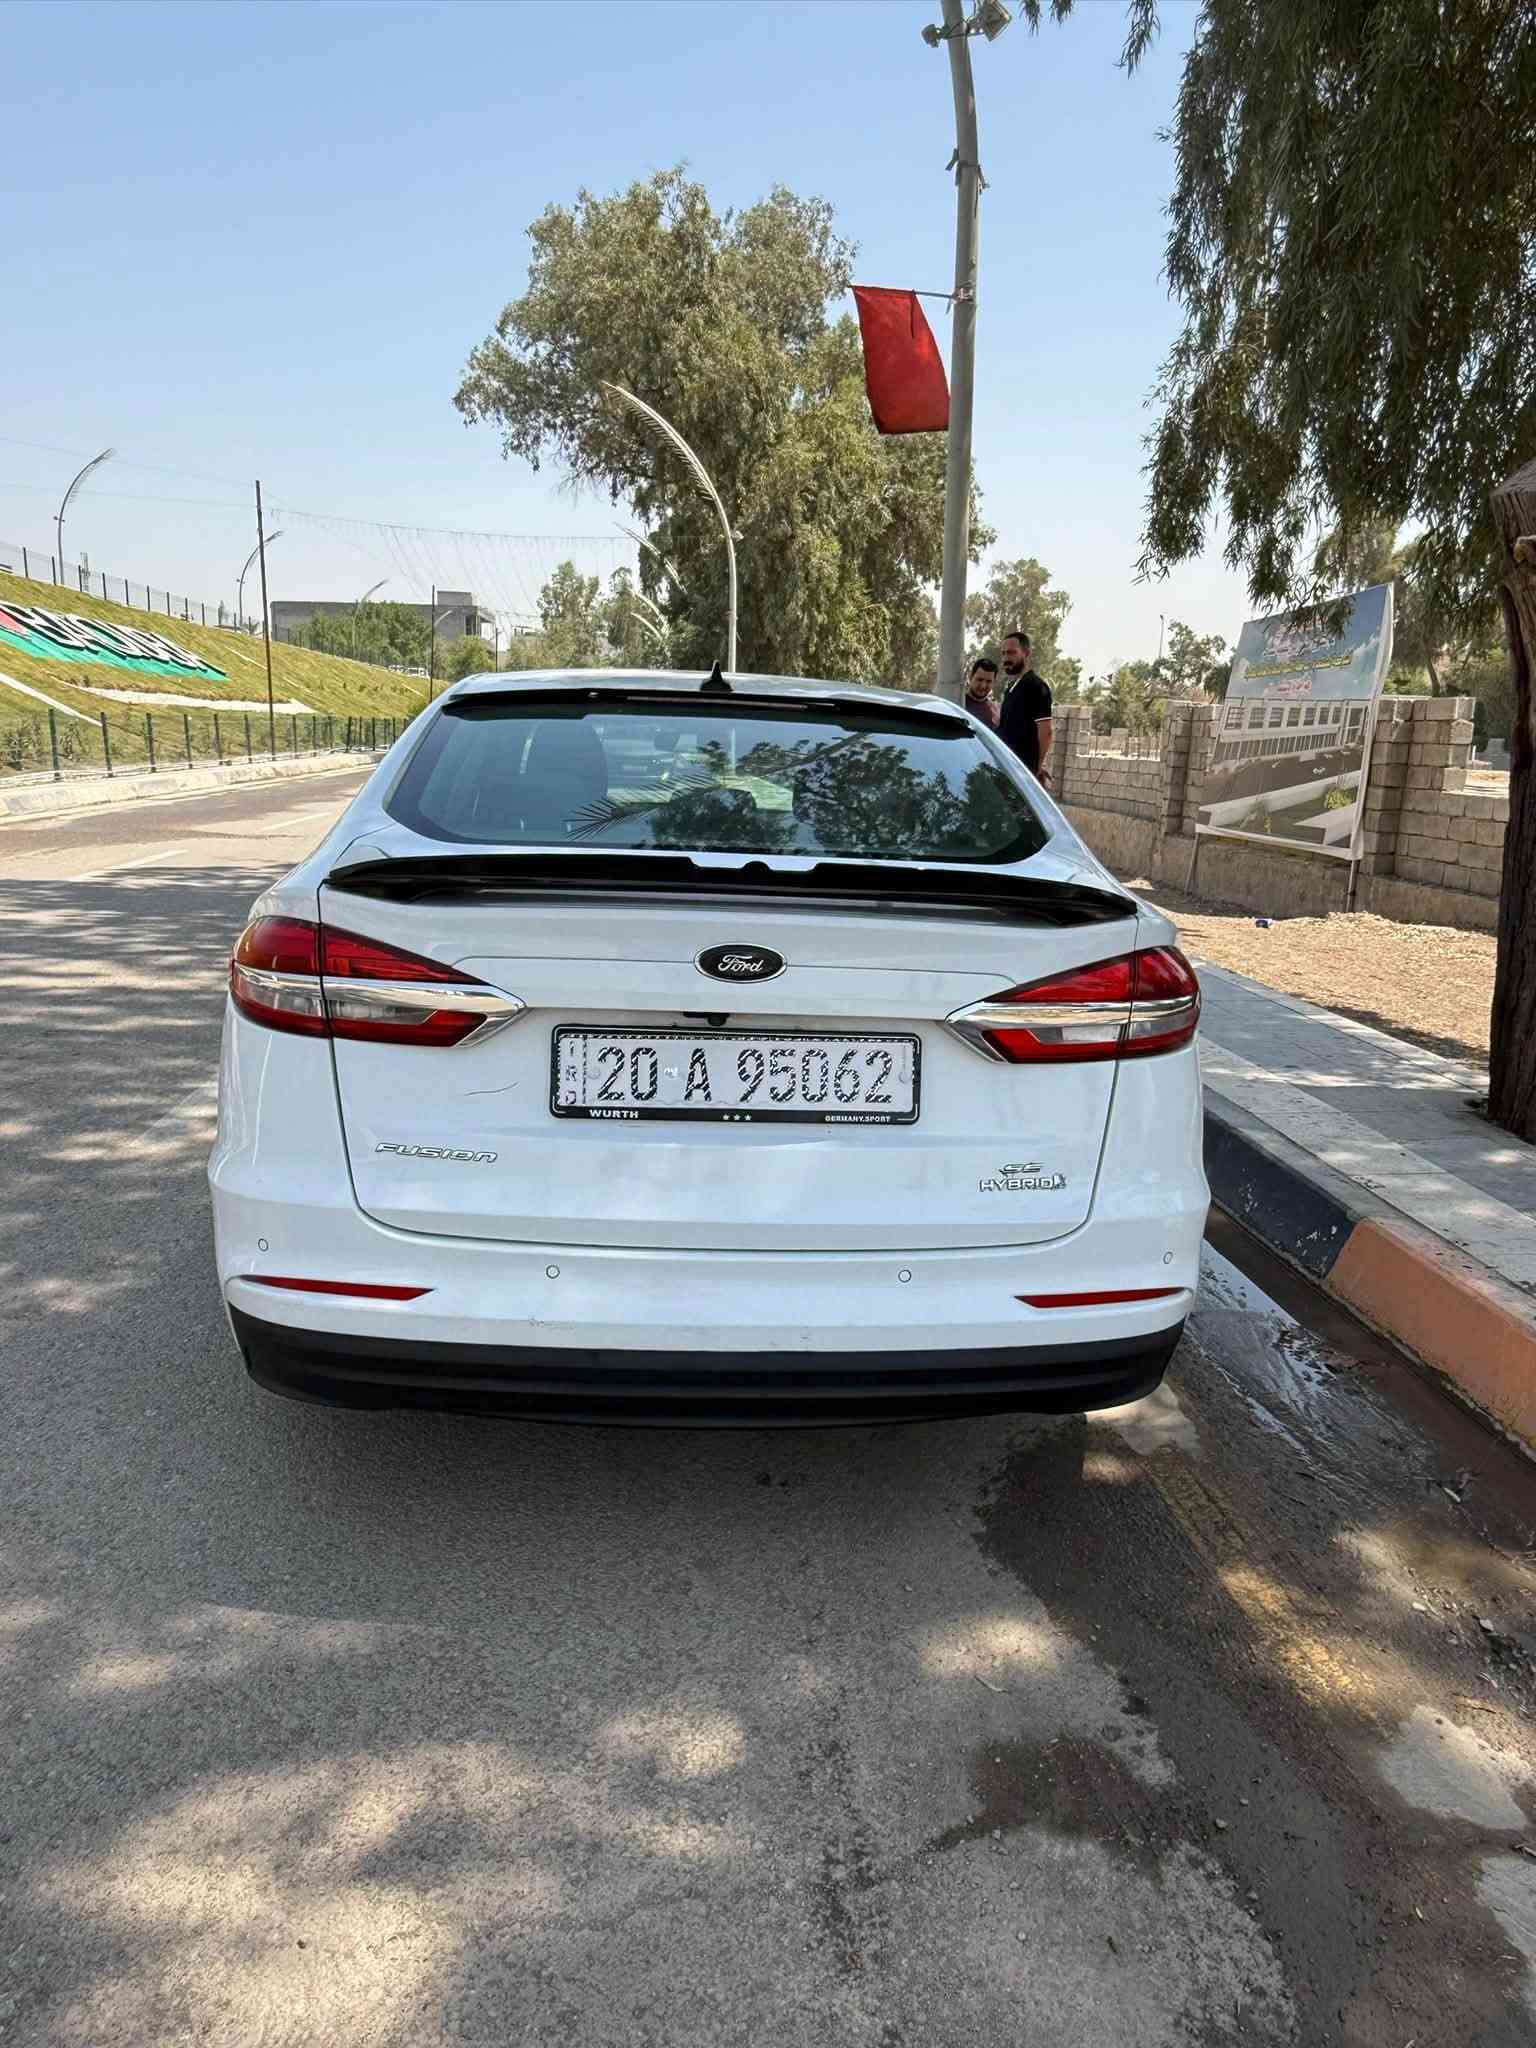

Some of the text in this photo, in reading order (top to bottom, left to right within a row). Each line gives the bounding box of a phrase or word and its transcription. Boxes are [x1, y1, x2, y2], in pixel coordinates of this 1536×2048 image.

[717, 954, 765, 973] Ford
[597, 1046, 893, 1104] 20 A 95062
[588, 1108, 640, 1119] WURTH
[979, 1177, 1054, 1192] HYBRID
